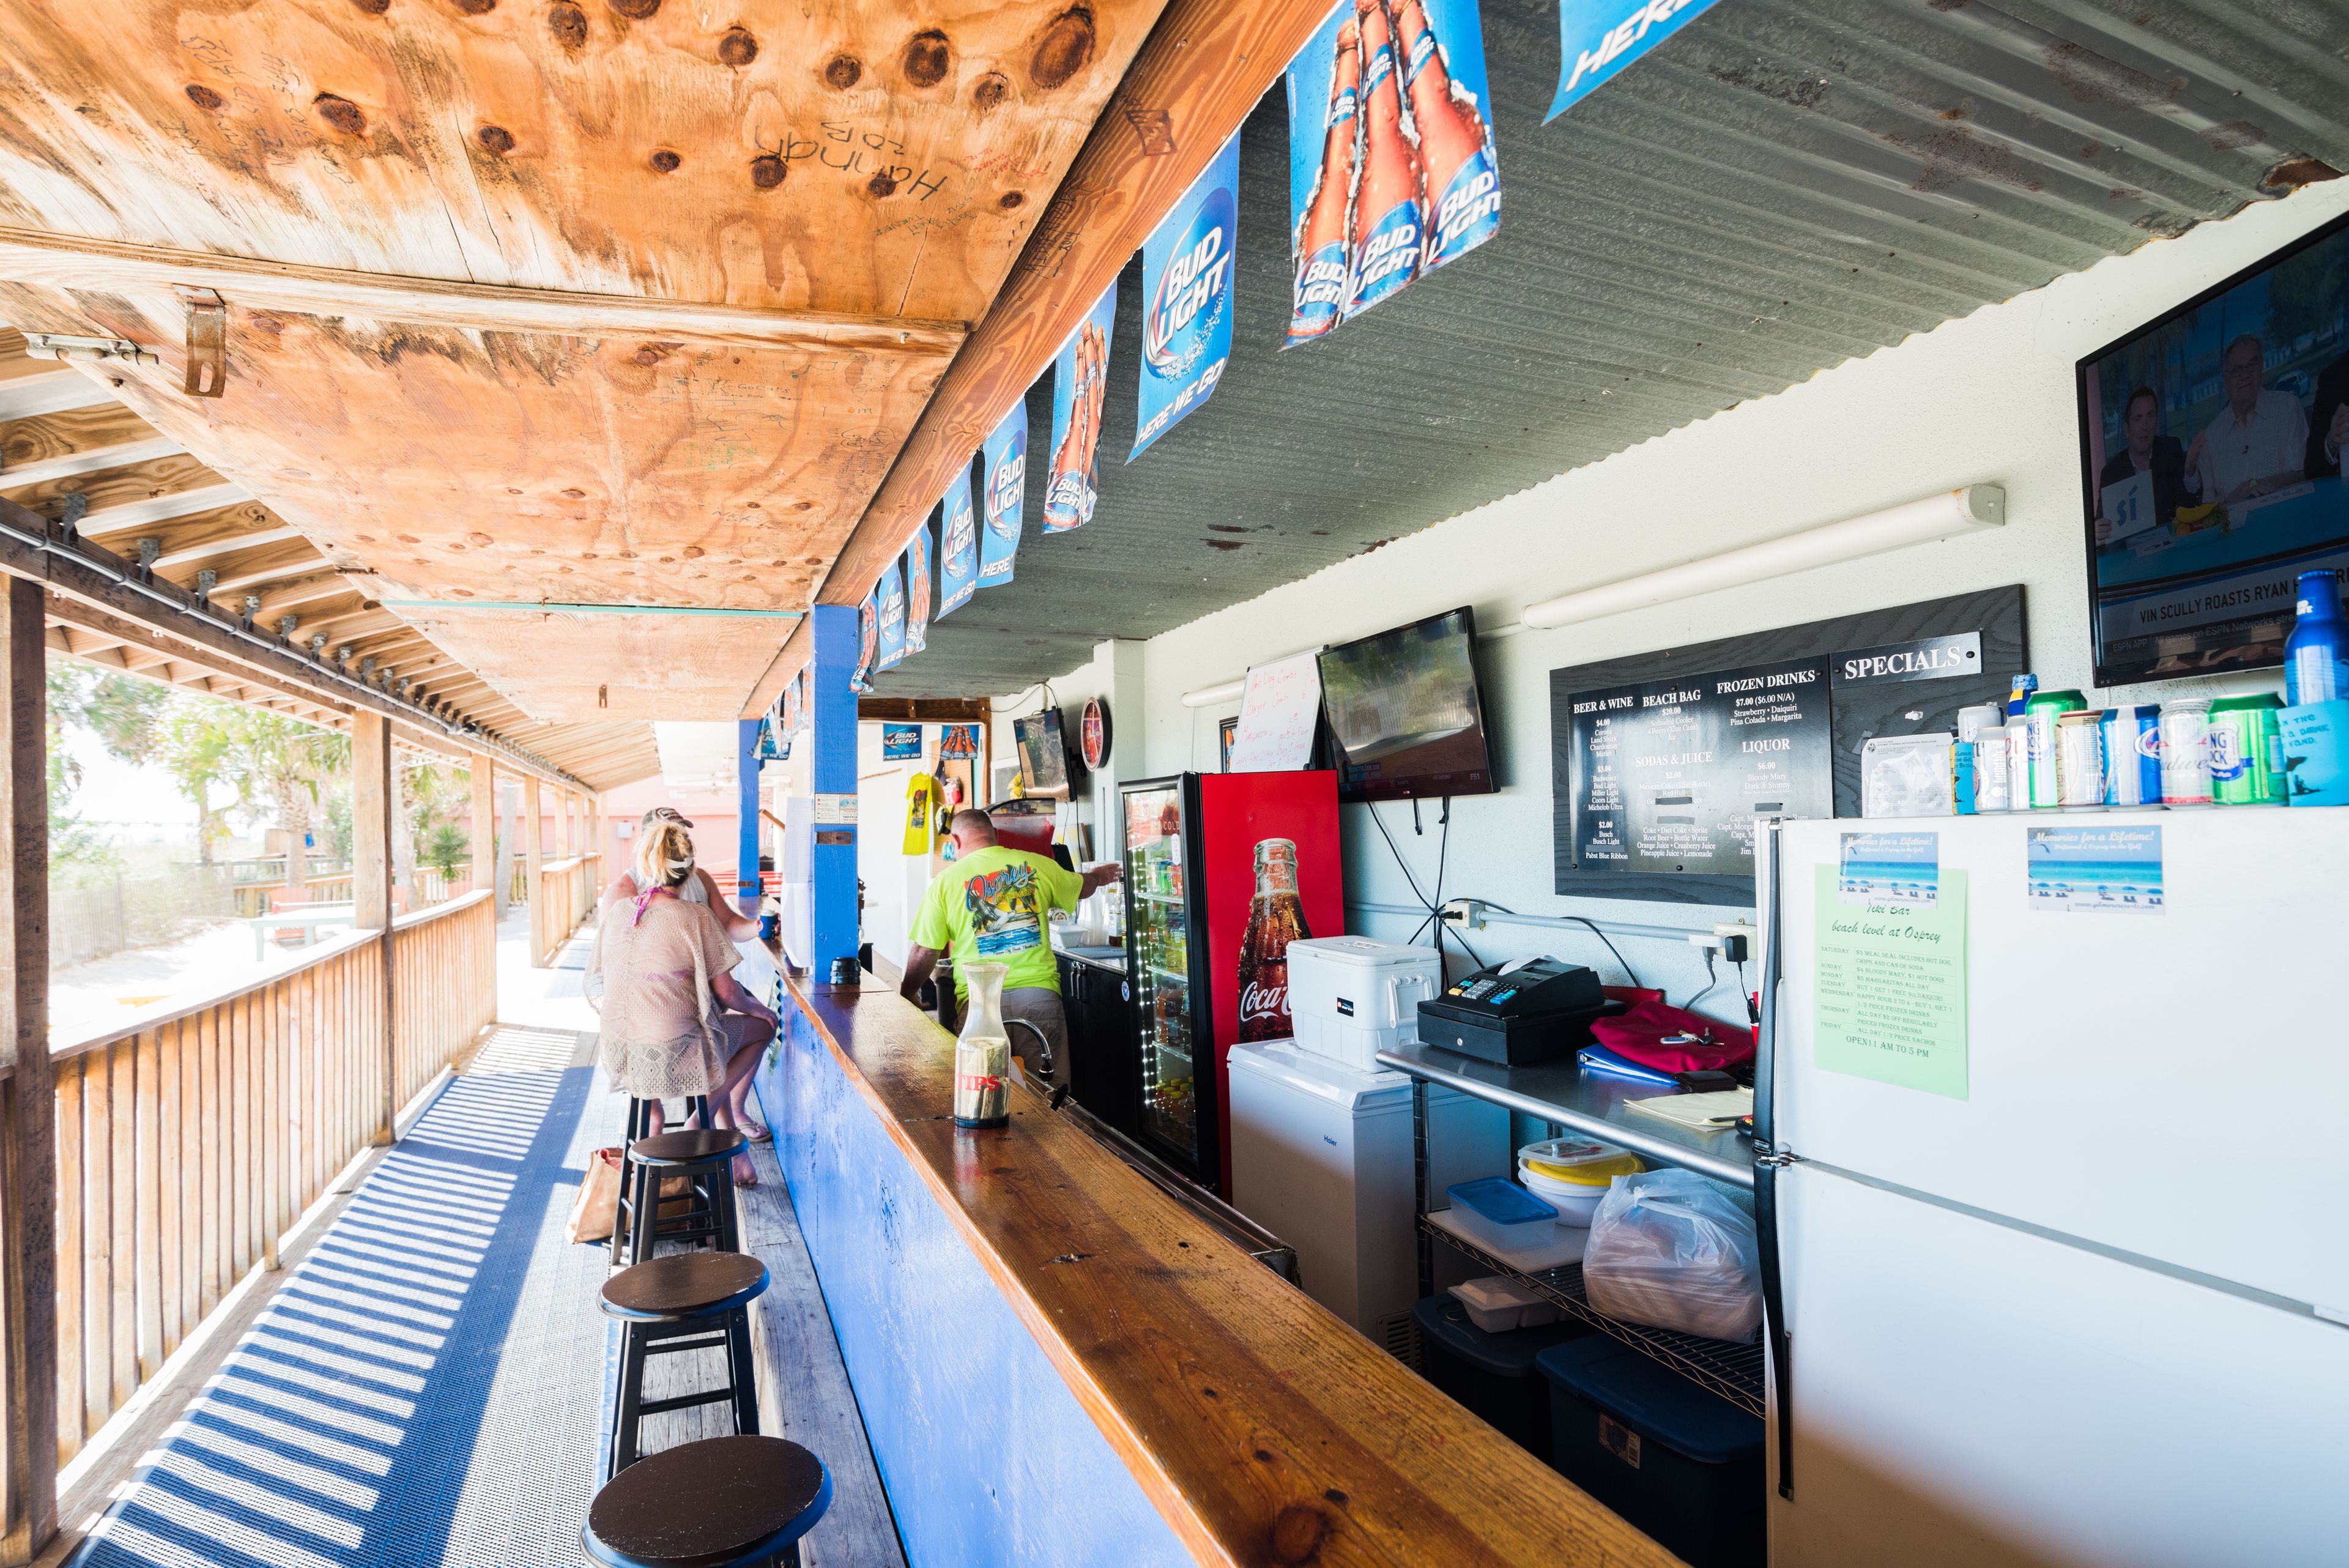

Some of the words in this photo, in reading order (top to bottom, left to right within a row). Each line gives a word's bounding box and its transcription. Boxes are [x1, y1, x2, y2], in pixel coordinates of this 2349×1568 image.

[756, 125, 948, 201] Hannah
[1437, 171, 1494, 234] BUD
[1427, 191, 1501, 264] LIGHT
[1361, 224, 1416, 272] BUD
[1166, 226, 1222, 308] BUD
[1305, 261, 1345, 282] BUD
[1349, 247, 1420, 303] LIGHT
[1156, 251, 1230, 353] LIGHT
[1296, 282, 1344, 307] LIGHT
[1135, 403, 1171, 448] HERE
[1171, 385, 1199, 417] WE
[1195, 357, 1226, 395] GO
[998, 455, 1023, 490] BUD
[993, 478, 1025, 516] LIGHT
[954, 506, 971, 535] BUD
[948, 526, 974, 559] LIGHT
[980, 556, 1009, 578] HERE
[888, 592, 901, 611] BUD
[942, 593, 956, 612] HERE
[2140, 608, 2157, 624] VIN
[2160, 598, 2202, 620] SCULLY
[2205, 588, 2250, 611] ROASTS
[2254, 579, 2288, 601] RYAN
[884, 604, 904, 630] LIGHT
[2112, 641, 2131, 652] ESPN
[2133, 638, 2148, 649] APP
[2154, 635, 2164, 646] All
[2165, 633, 2192, 647] games
[2194, 630, 2203, 639] on
[2206, 623, 2230, 636] ESPN
[2232, 615, 2274, 632] Networks
[2276, 613, 2295, 625] stre
[1845, 646, 1961, 680] SPECIALS
[1716, 677, 1764, 694] FROZEN
[1767, 670, 1815, 688] DRINKS
[1573, 702, 1598, 713] BEER
[1599, 700, 1606, 710] &
[1608, 696, 1633, 709] WINE
[1642, 693, 1677, 707] BEACH
[1679, 689, 1701, 702] BAG
[1735, 697, 1754, 707] $7.00
[1755, 694, 1776, 706] ($6.00
[1777, 692, 1795, 702] N/A)
[1662, 707, 1681, 716] $20.00
[1734, 708, 1766, 717] Strawberry
[1771, 703, 1797, 713] Daiquiri
[1745, 716, 1766, 724] Colada
[1771, 712, 1802, 723] Margarita
[1596, 718, 1610, 727] $4.00
[1742, 738, 1791, 754] LIQUOR
[1636, 754, 1668, 767] SODAS
[1671, 754, 1679, 765] &
[1681, 751, 1713, 765] JUICE
[1757, 762, 1776, 770] $6.00
[1597, 765, 1611, 773] $3.00
[1748, 773, 1769, 782] Bloody
[1770, 773, 1787, 782] Mary
[1768, 781, 1791, 790] Stormy
[1604, 782, 1616, 790] Light
[1606, 789, 1619, 798] Light
[1606, 797, 1619, 805] Light
[1163, 821, 1180, 830] COLD
[1717, 823, 1732, 831] Capt.
[1731, 831, 1746, 840] Capt.
[1879, 836, 1891, 847] for
[2033, 832, 2078, 843] Memories
[2080, 831, 2096, 844] for
[2108, 830, 2156, 842] Lifetime!
[1641, 849, 1665, 858] Pineapple
[1674, 842, 1701, 850] Cranberry
[966, 861, 1037, 912] Osprey
[1831, 920, 1859, 933] beach
[1863, 923, 1886, 935] level
[1888, 927, 1901, 937] at
[1904, 926, 1941, 945] Osprey
[1899, 954, 1926, 963] INCLUDES
[1865, 976, 1904, 986] MARGARITAS
[1820, 987, 1855, 998] WEDNESDAY
[1886, 1005, 1908, 1014] FROZEN
[1909, 1009, 1931, 1017] DRINKS
[1857, 1018, 1877, 1027] PRICED
[1879, 1022, 1900, 1031] FROZEN
[1901, 1025, 1923, 1034] DRINKS
[1902, 1017, 1939, 1028] REGULARLY
[1880, 1042, 1893, 1051] AM
[1896, 1044, 1907, 1053] TO
[1909, 1047, 1914, 1055] 5
[1917, 1049, 1929, 1058] PM
[957, 1074, 1000, 1091] TIPS
[1324, 1135, 1337, 1147] Haier
